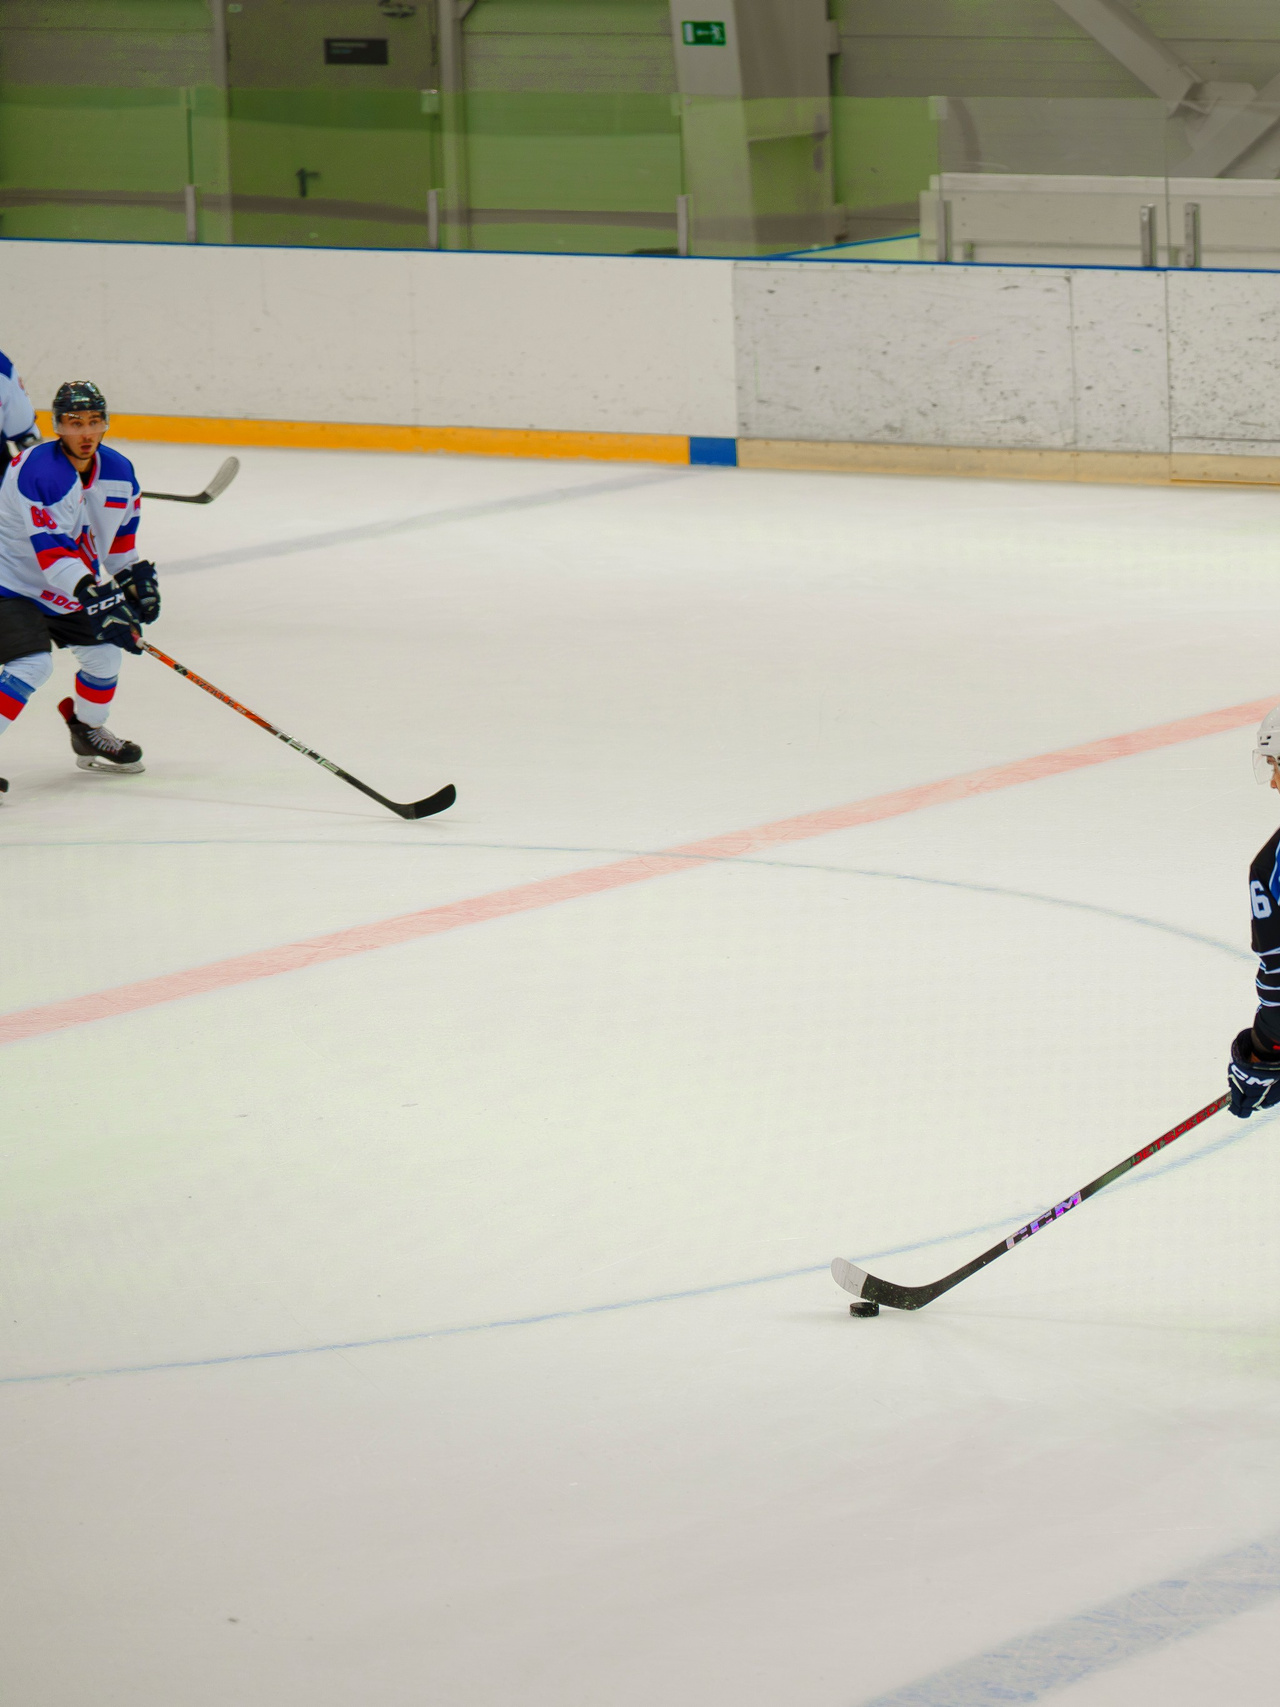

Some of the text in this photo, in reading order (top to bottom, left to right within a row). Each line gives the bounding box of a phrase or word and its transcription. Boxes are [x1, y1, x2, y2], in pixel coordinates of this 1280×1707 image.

[1250, 880, 1272, 919] 6
[1132, 1102, 1219, 1166] JETSPEED
[1005, 1190, 1082, 1250] CCM
